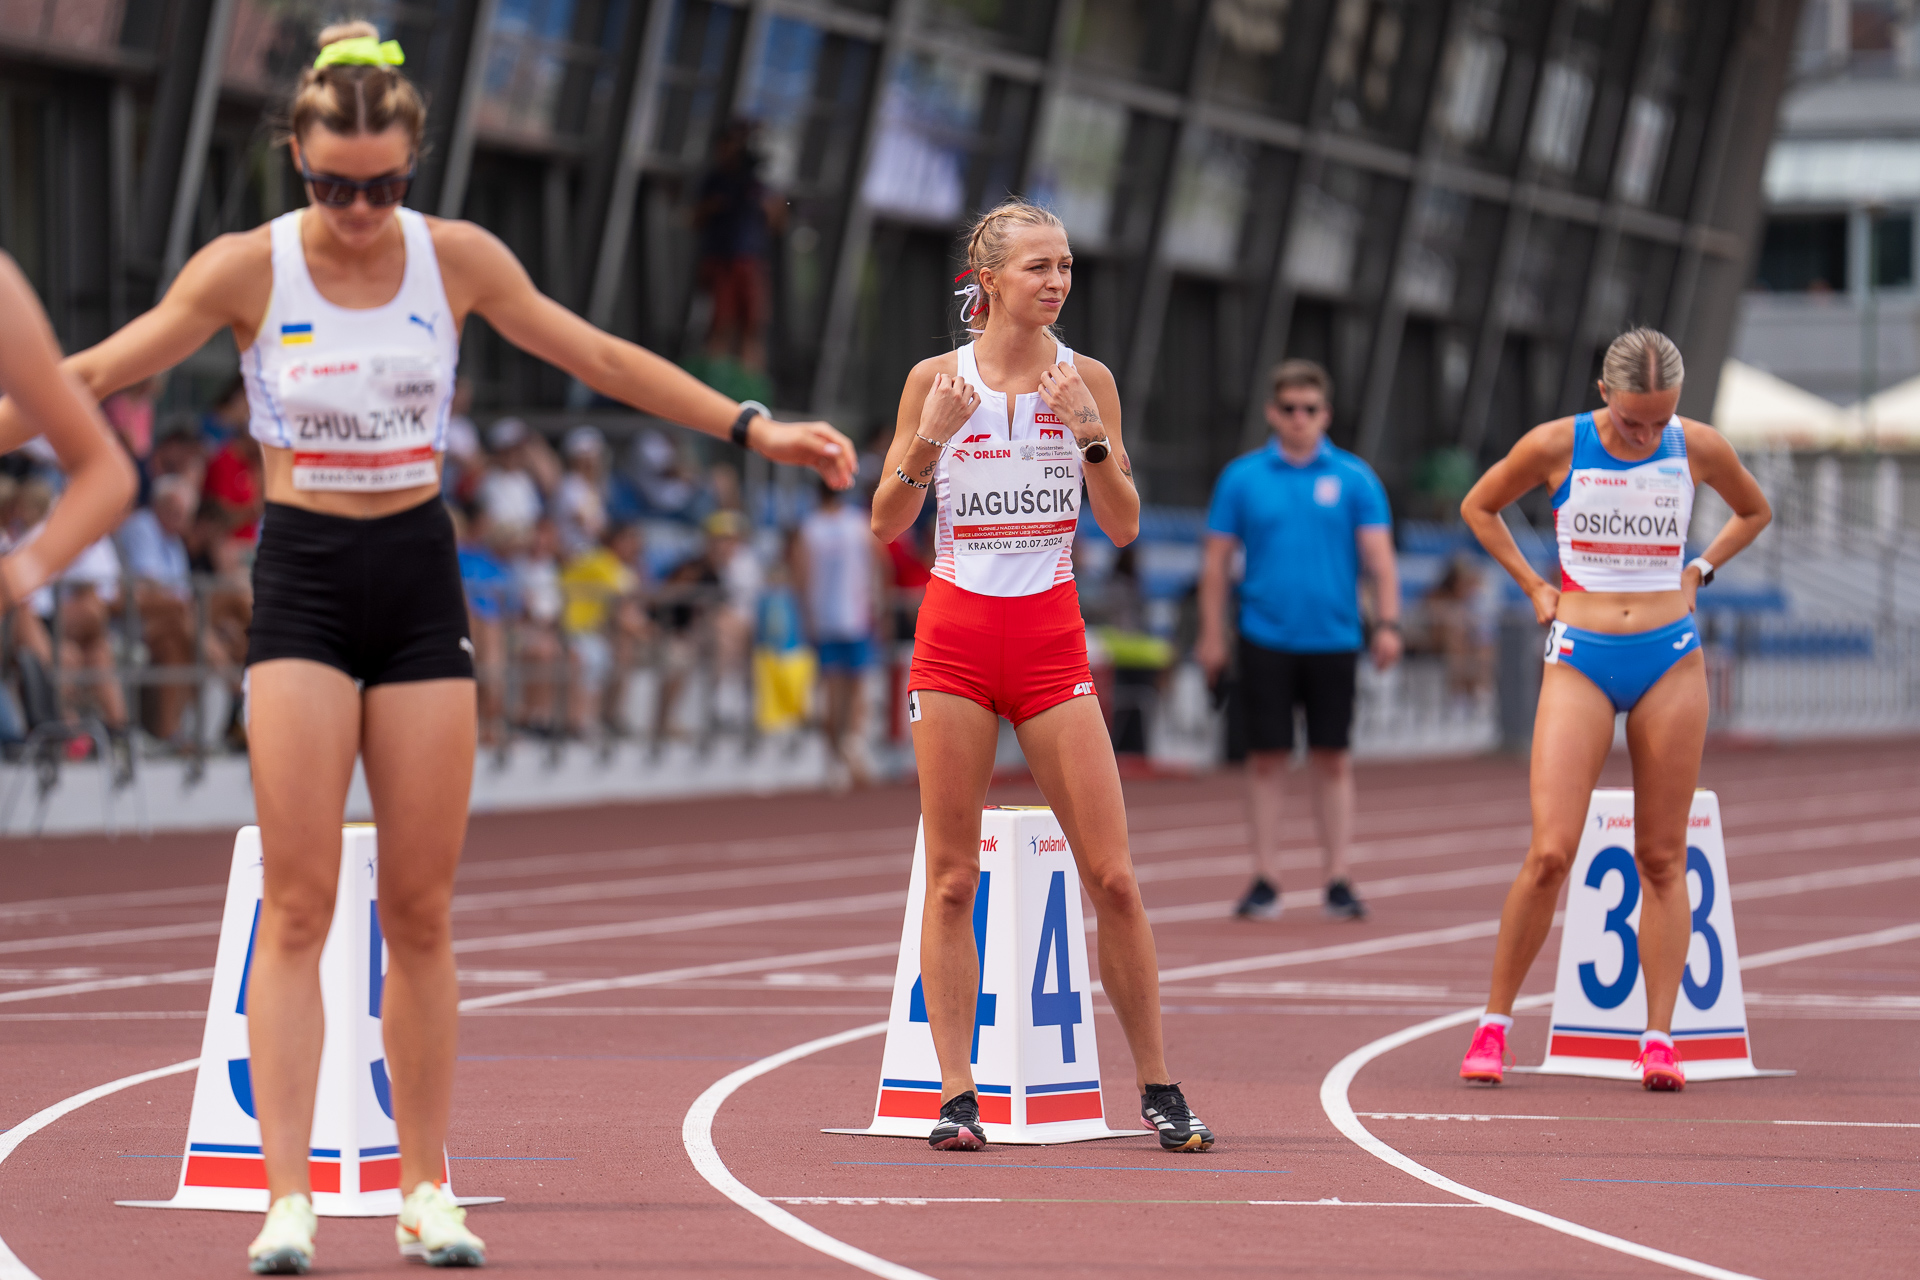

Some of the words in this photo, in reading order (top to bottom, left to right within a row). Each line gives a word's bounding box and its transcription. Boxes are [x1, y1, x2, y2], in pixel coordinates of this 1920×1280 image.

[312, 362, 359, 377] ORLEN
[296, 406, 427, 441] ZHULZHYK
[1037, 414, 1063, 423] ORLE
[973, 449, 1011, 460] ORLEN
[1044, 466, 1074, 479] POL
[1594, 477, 1627, 486] ORLEN
[955, 483, 1075, 517] JAGUŚCIK
[1655, 496, 1680, 508] CZE
[1574, 508, 1679, 536] OSIČKOVÁ
[968, 539, 1012, 551] KRAKÓW
[1015, 536, 1063, 549] 20.07.2024
[1606, 814, 1635, 832] pola
[1038, 836, 1067, 857] polanik
[1578, 844, 1642, 1010] 3
[1682, 844, 1724, 1011] 3
[1031, 870, 1083, 1064] 4
